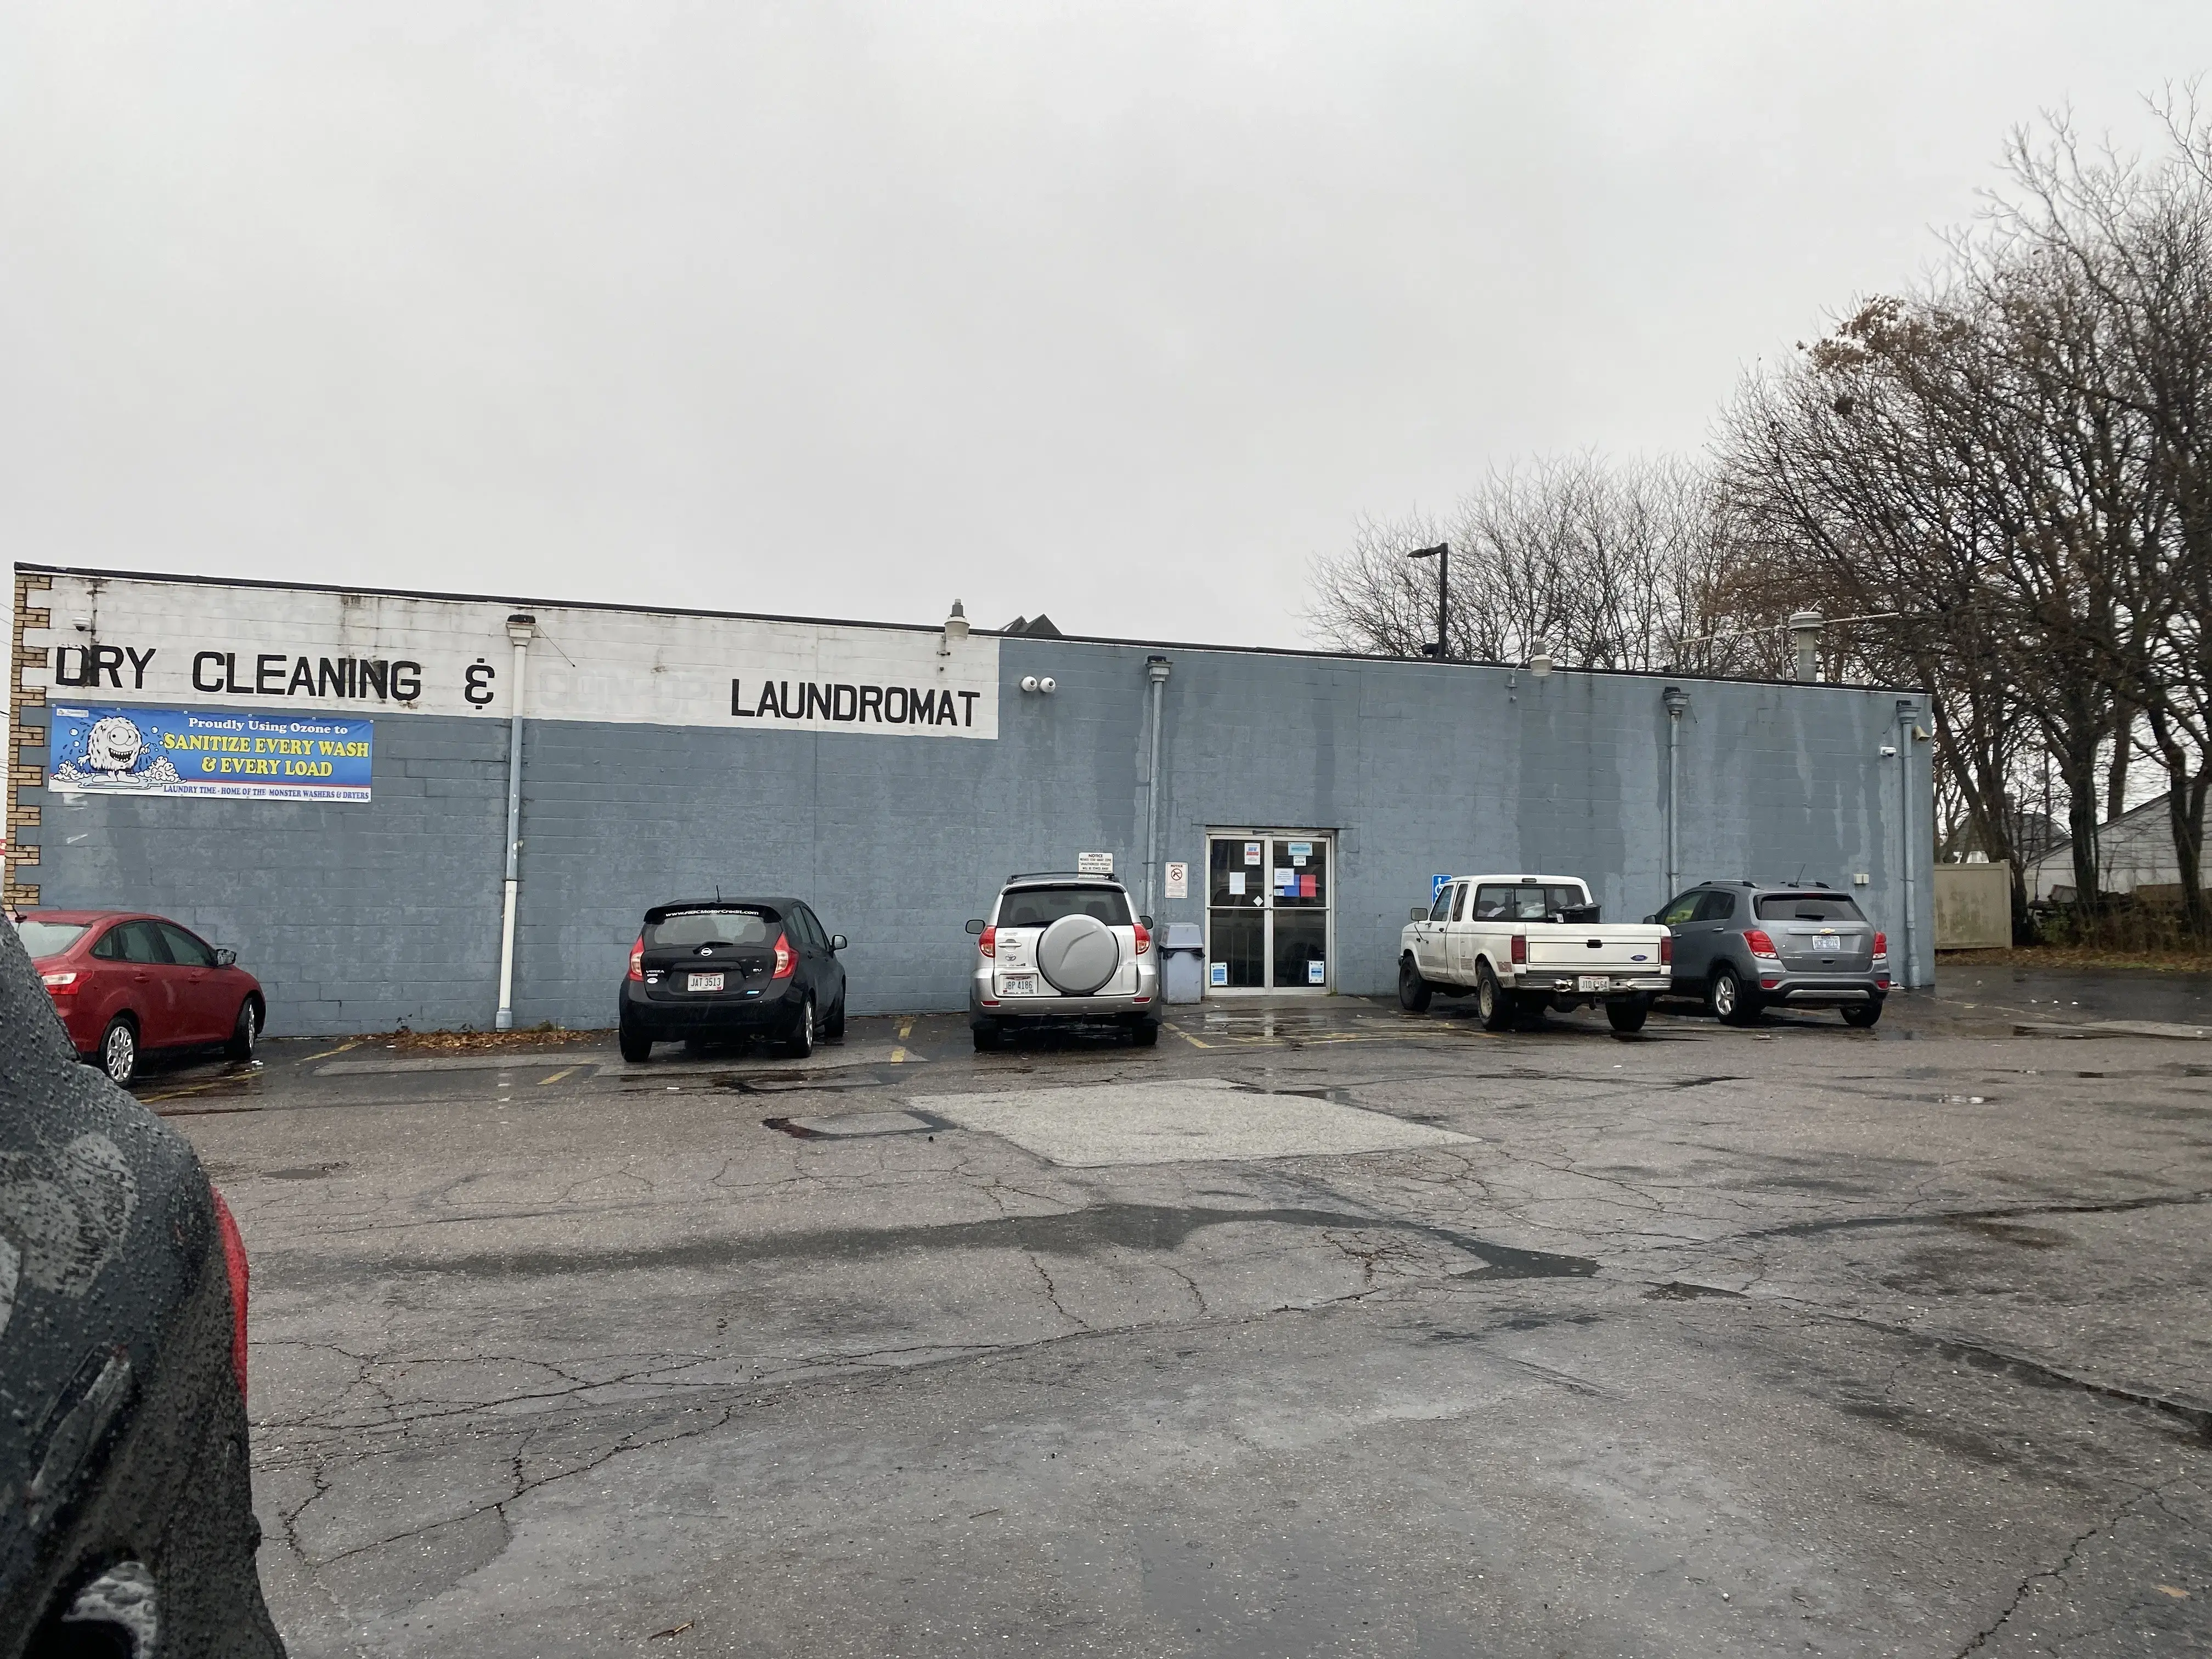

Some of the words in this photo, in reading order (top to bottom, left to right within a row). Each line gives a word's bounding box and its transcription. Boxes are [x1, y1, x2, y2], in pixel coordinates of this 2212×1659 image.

[56, 644, 156, 689] DRY
[193, 651, 421, 701] CLEANING
[465, 658, 495, 710] &
[731, 679, 980, 727] LAUNDROMAT
[188, 718, 245, 731] Proudly
[248, 720, 287, 734] Using
[290, 723, 331, 733] Ozone
[334, 725, 348, 734] to
[164, 733, 251, 753] SANITIZE
[255, 737, 315, 755] EVERY
[318, 740, 369, 758] WASH
[201, 756, 217, 772] &
[220, 757, 281, 775] EVERY
[285, 759, 333, 777] LOAD
[163, 785, 198, 793] LAUNDRY
[269, 788, 301, 797] MONSTER
[303, 790, 335, 798] WASHERS
[691, 978, 703, 987] JAT
[704, 977, 721, 987] 3513
[1005, 981, 1015, 990] JBP
[1017, 980, 1032, 990] 4186
